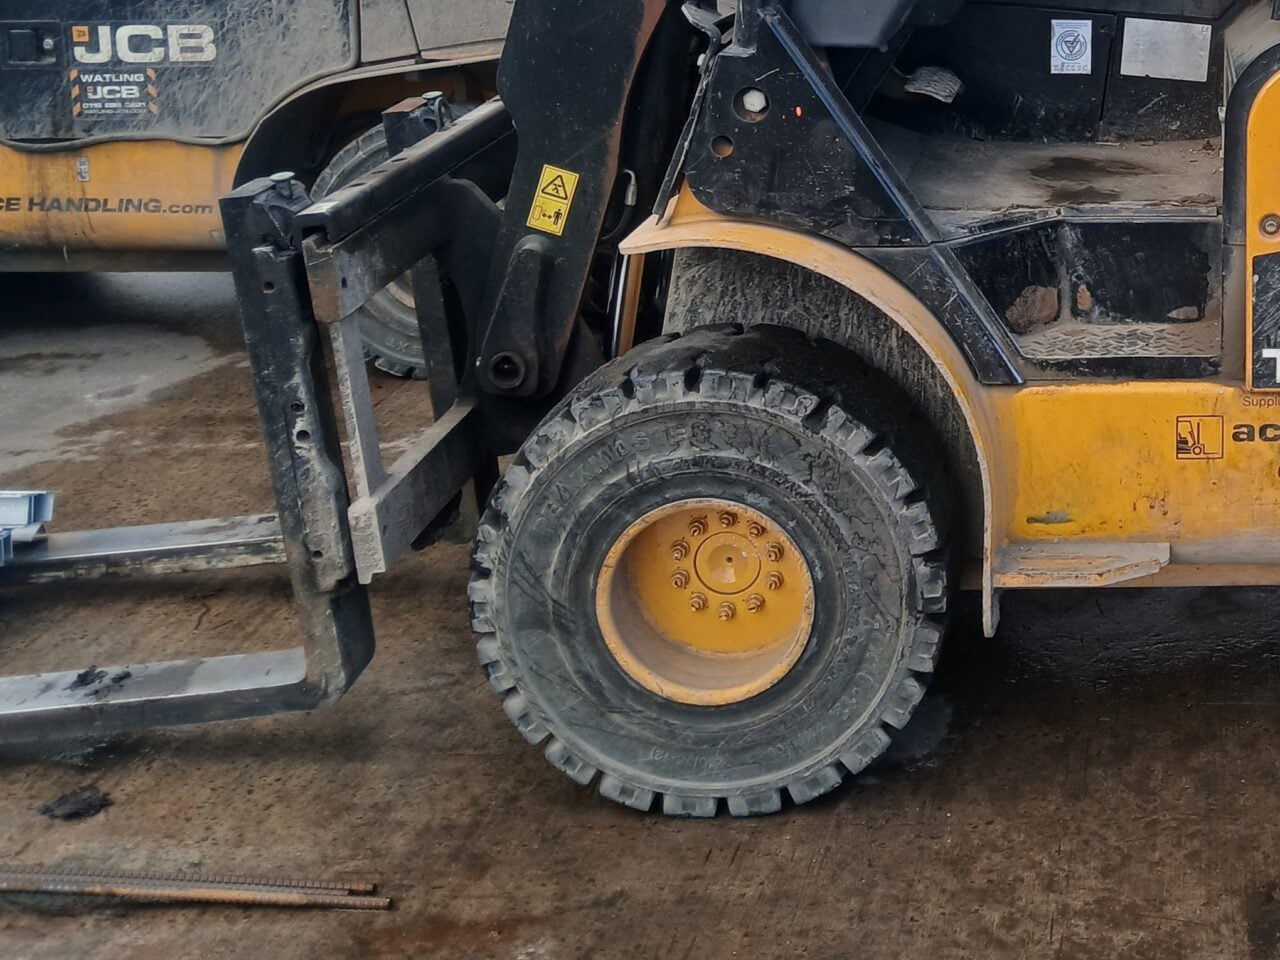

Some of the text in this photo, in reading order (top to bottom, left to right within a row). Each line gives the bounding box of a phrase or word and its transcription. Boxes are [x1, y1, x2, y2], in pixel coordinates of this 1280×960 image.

[73, 24, 217, 64] JCB
[80, 73, 145, 83] WATLING
[86, 85, 141, 100] JCB
[27, 197, 214, 215] HANDLING.com
